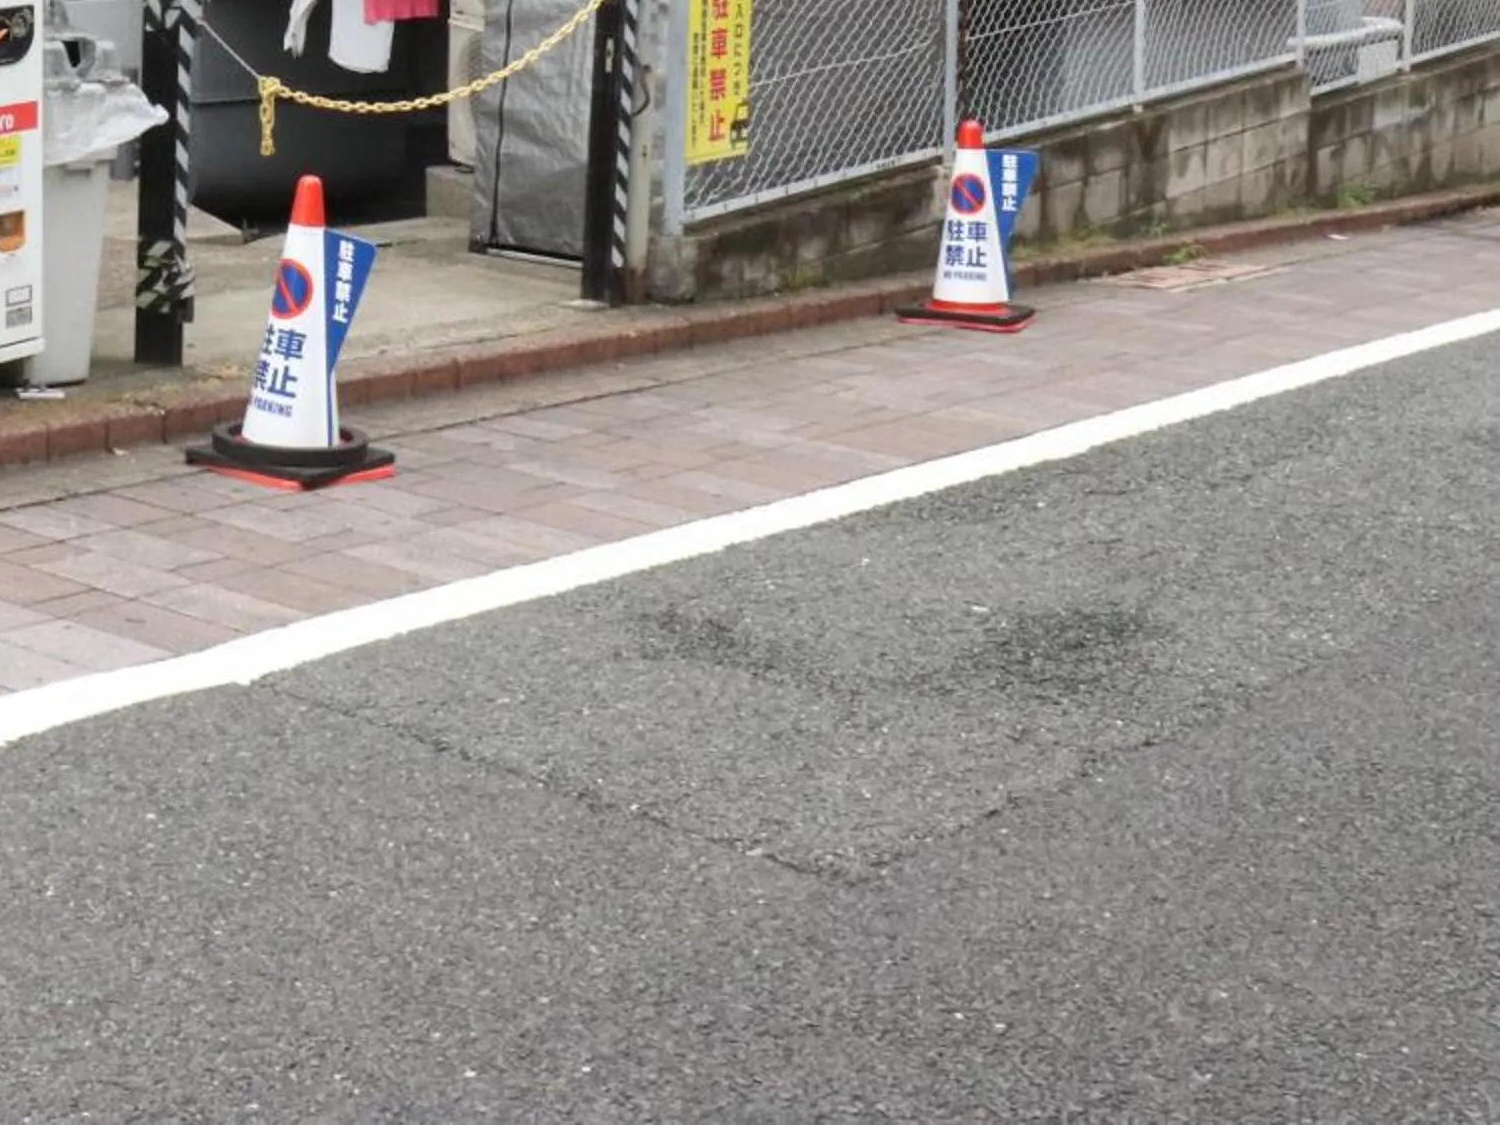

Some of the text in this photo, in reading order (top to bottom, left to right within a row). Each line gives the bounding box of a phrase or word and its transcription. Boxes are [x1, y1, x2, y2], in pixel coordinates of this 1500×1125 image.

[947, 219, 990, 242] 駐車
[945, 244, 988, 267] 禁止
[332, 239, 355, 323] 駐車禁止
